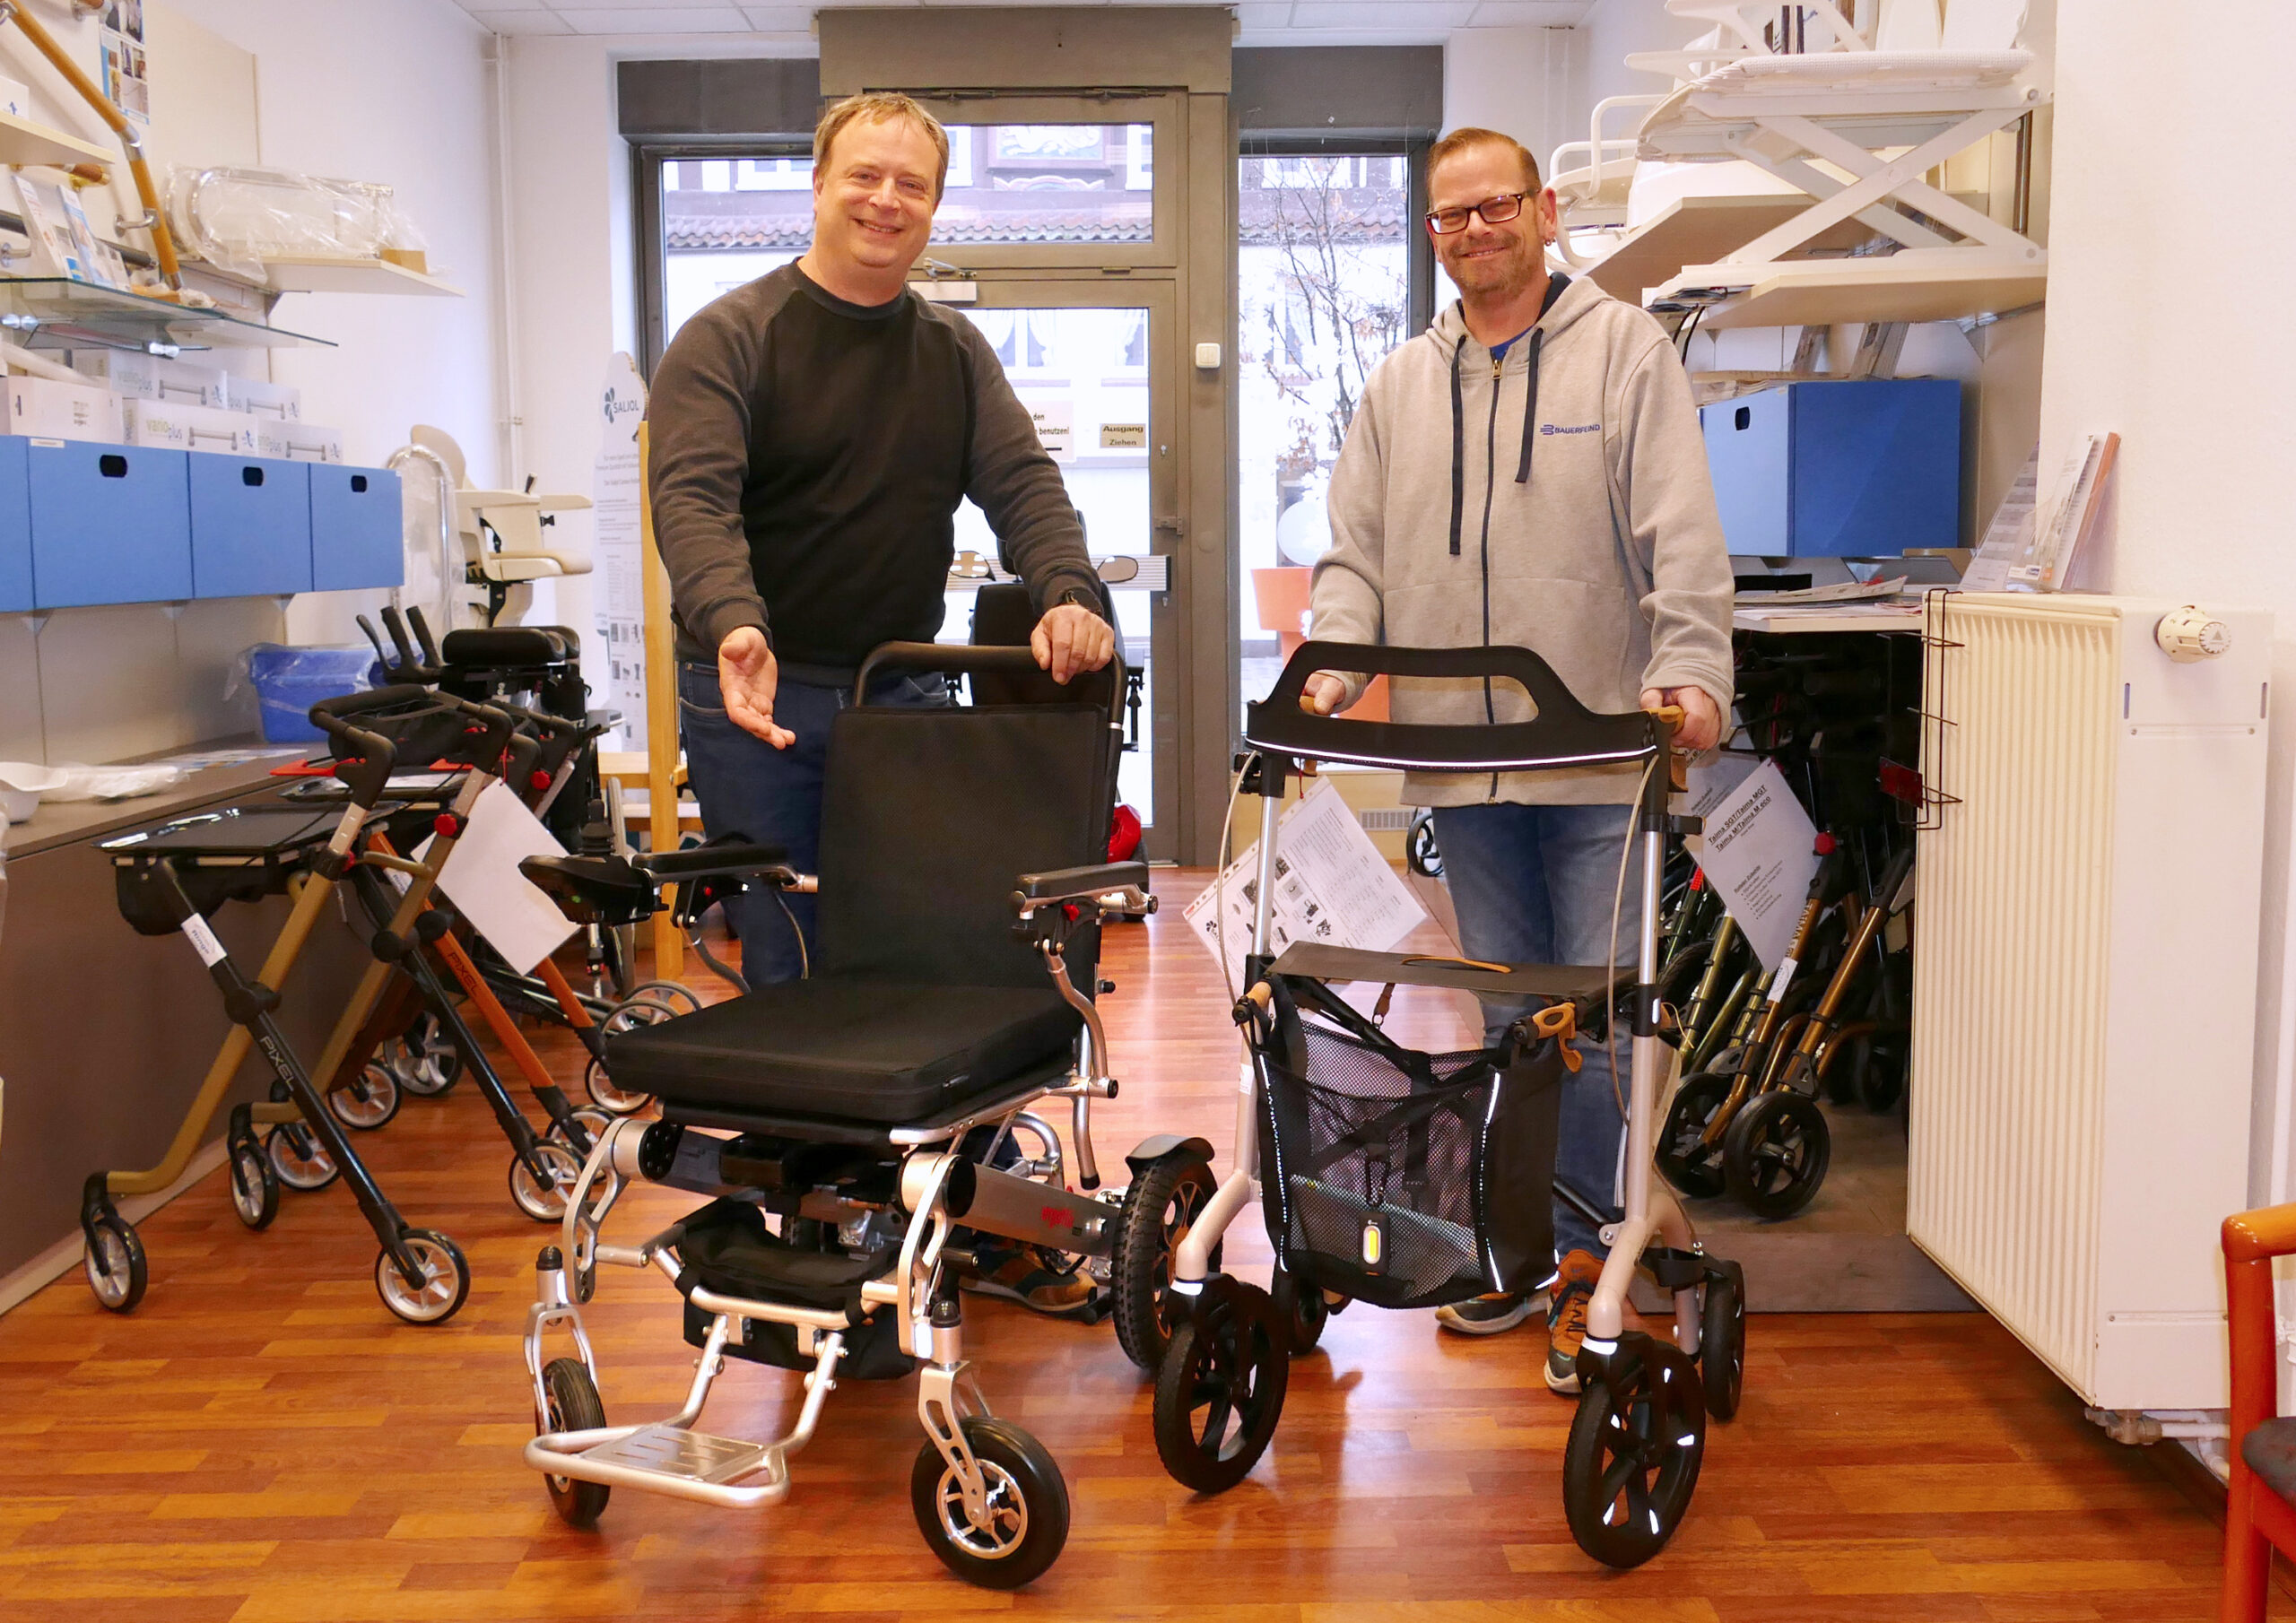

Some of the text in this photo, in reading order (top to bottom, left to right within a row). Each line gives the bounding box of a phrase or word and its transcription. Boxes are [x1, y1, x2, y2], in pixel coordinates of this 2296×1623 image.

[613, 400, 639, 415] SALJOL
[1033, 412, 1044, 421] den
[1102, 425, 1144, 434] Ausgang
[1554, 423, 1601, 434] BAUERFEIND
[448, 951, 479, 997] PIXEL
[260, 1036, 294, 1091] PIXEL
